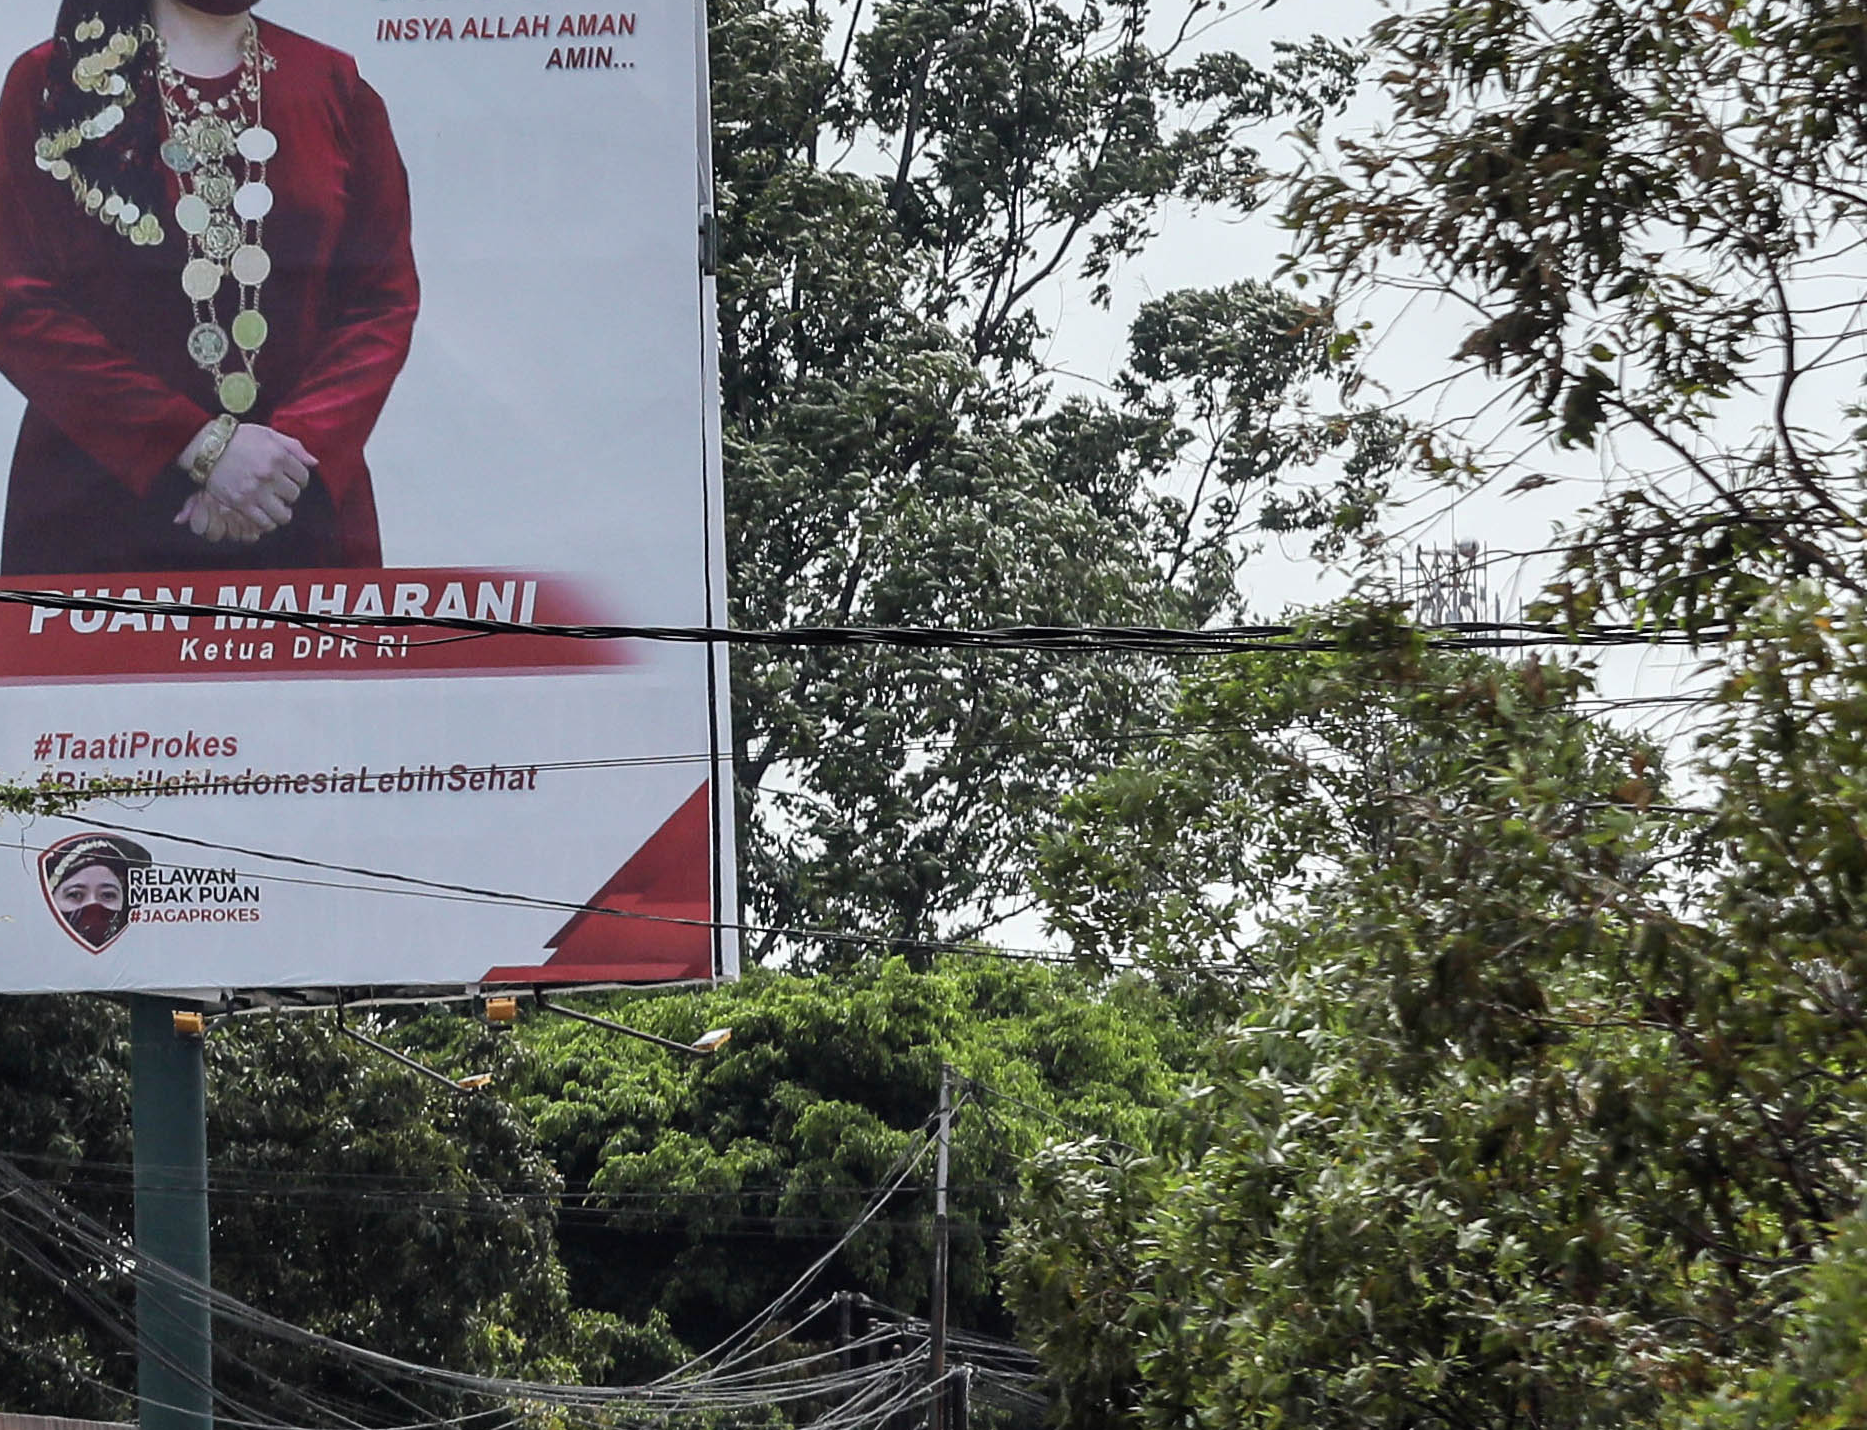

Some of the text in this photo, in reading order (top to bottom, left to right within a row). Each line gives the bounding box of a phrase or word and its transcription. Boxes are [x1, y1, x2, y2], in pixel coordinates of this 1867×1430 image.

[377, 14, 636, 42] INSYA ALLAH AMAN
[545, 46, 635, 71] AMIN...
[29, 581, 537, 635] PUAN MAHARANI
[179, 634, 409, 662] Ketua DPR RI
[34, 731, 239, 762] #TaatiProkes
[129, 868, 237, 887] RELAWAN
[130, 885, 261, 904] MBAK PUAN
[129, 906, 261, 925] #JAGAPROKES
